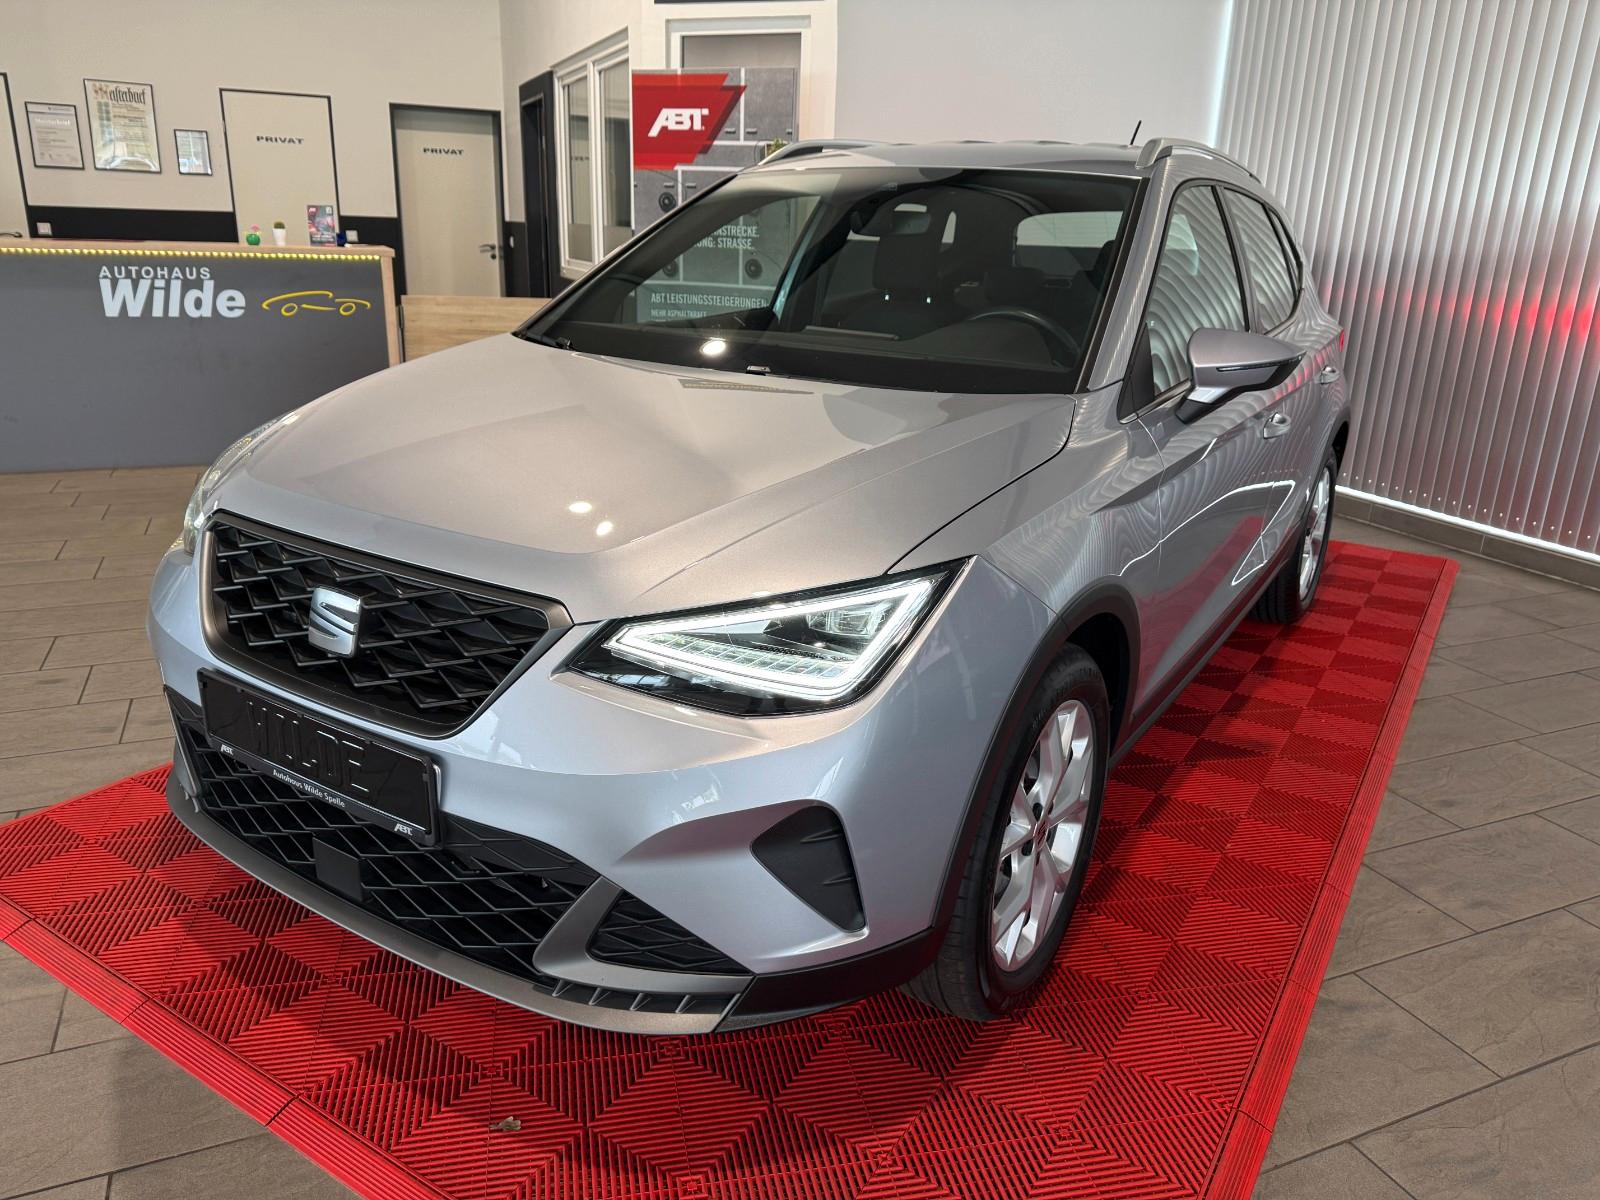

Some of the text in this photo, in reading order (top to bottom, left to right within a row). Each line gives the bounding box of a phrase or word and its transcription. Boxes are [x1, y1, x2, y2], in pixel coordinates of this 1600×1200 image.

[647, 107, 709, 138] ABT
[256, 135, 304, 144] PRIVAT
[423, 147, 464, 155] PRIVAT
[98, 265, 211, 279] AUTOHAUS
[98, 278, 246, 318] Wilde
[651, 292, 666, 304] ABT
[272, 769, 345, 808] Autohaus Wilde Spelle
